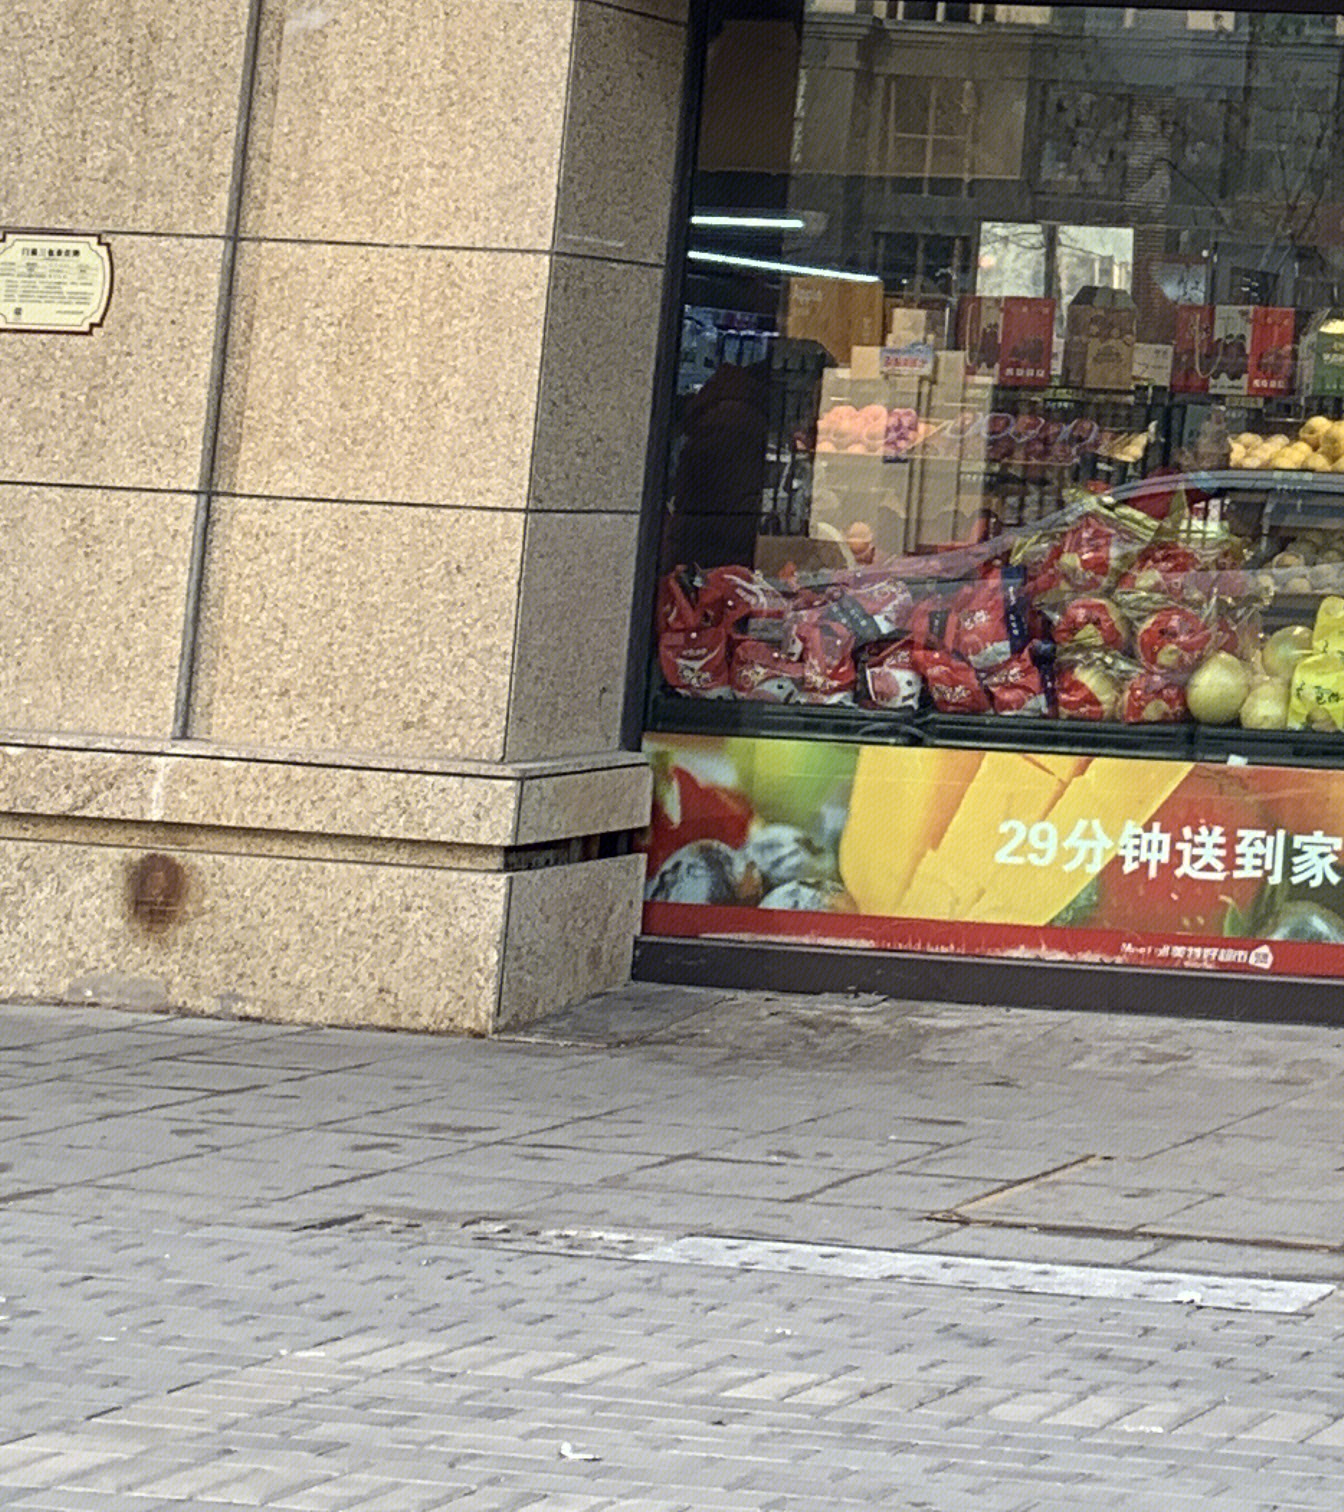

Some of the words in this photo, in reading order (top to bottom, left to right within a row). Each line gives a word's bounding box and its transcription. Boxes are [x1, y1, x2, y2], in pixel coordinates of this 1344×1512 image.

[994, 818, 1344, 889] 29分钟送到家
